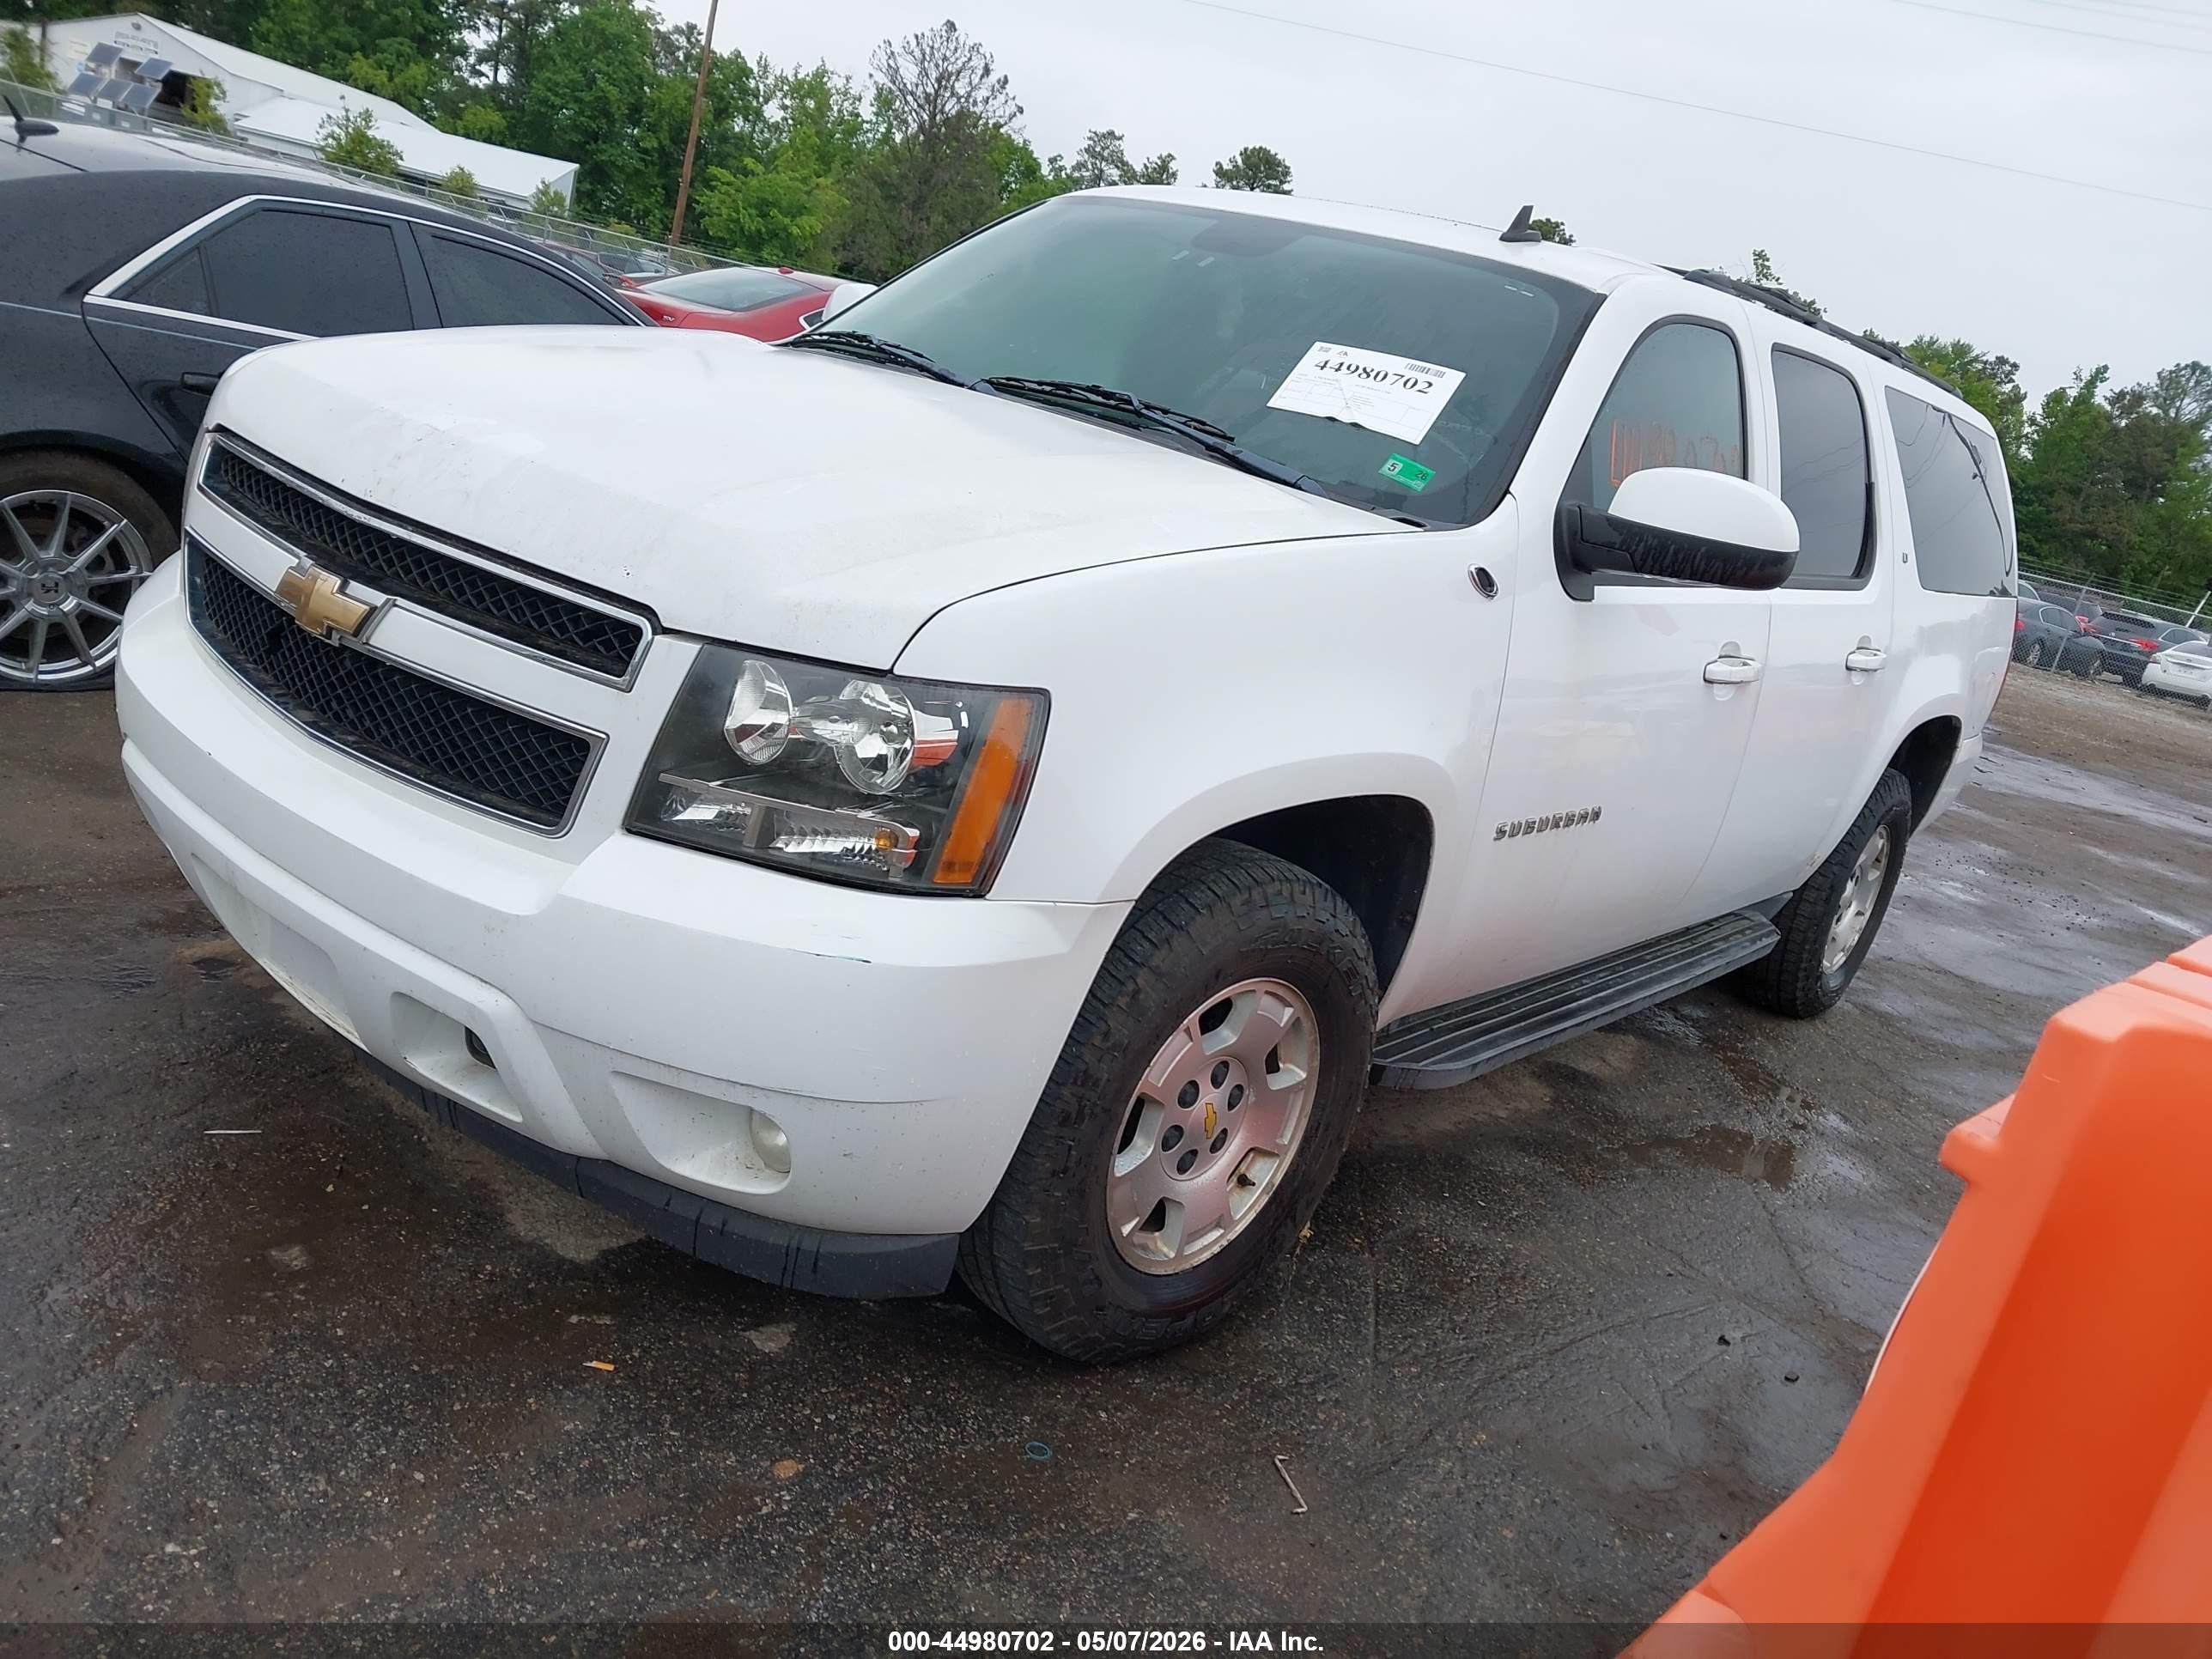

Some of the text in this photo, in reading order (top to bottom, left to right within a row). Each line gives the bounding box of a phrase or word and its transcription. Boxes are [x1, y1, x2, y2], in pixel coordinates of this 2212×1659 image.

[1314, 359, 1433, 394] 44980702
[1388, 462, 1400, 472] 5
[1493, 805, 1602, 842] SUBURBAN
